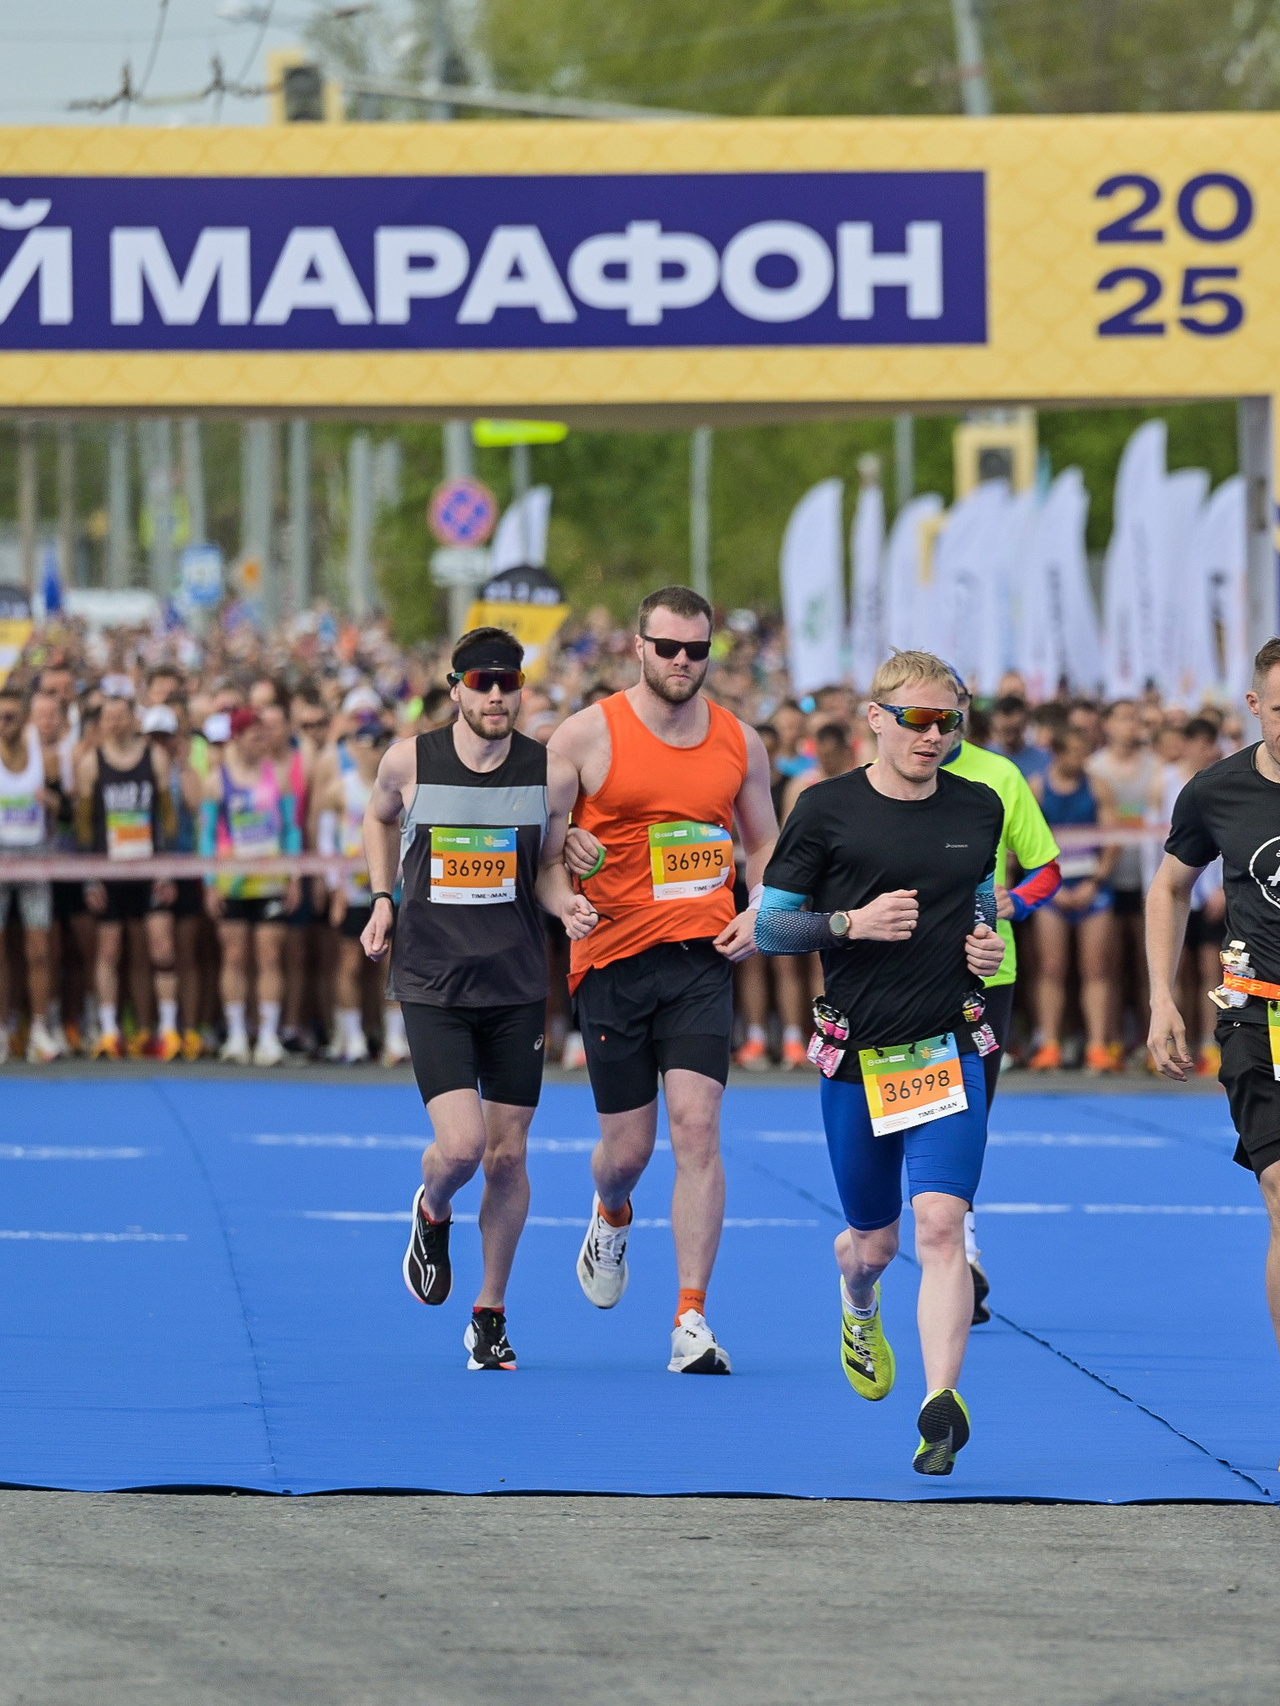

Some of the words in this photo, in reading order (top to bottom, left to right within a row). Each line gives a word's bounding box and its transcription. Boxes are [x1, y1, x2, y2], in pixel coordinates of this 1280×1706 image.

[1095, 171, 1255, 243] 20
[109, 220, 944, 326] МАРАФОН
[1096, 265, 1245, 336] 25
[446, 859, 506, 877] 36999
[666, 848, 724, 872] 36995
[883, 1069, 951, 1103] 36998
